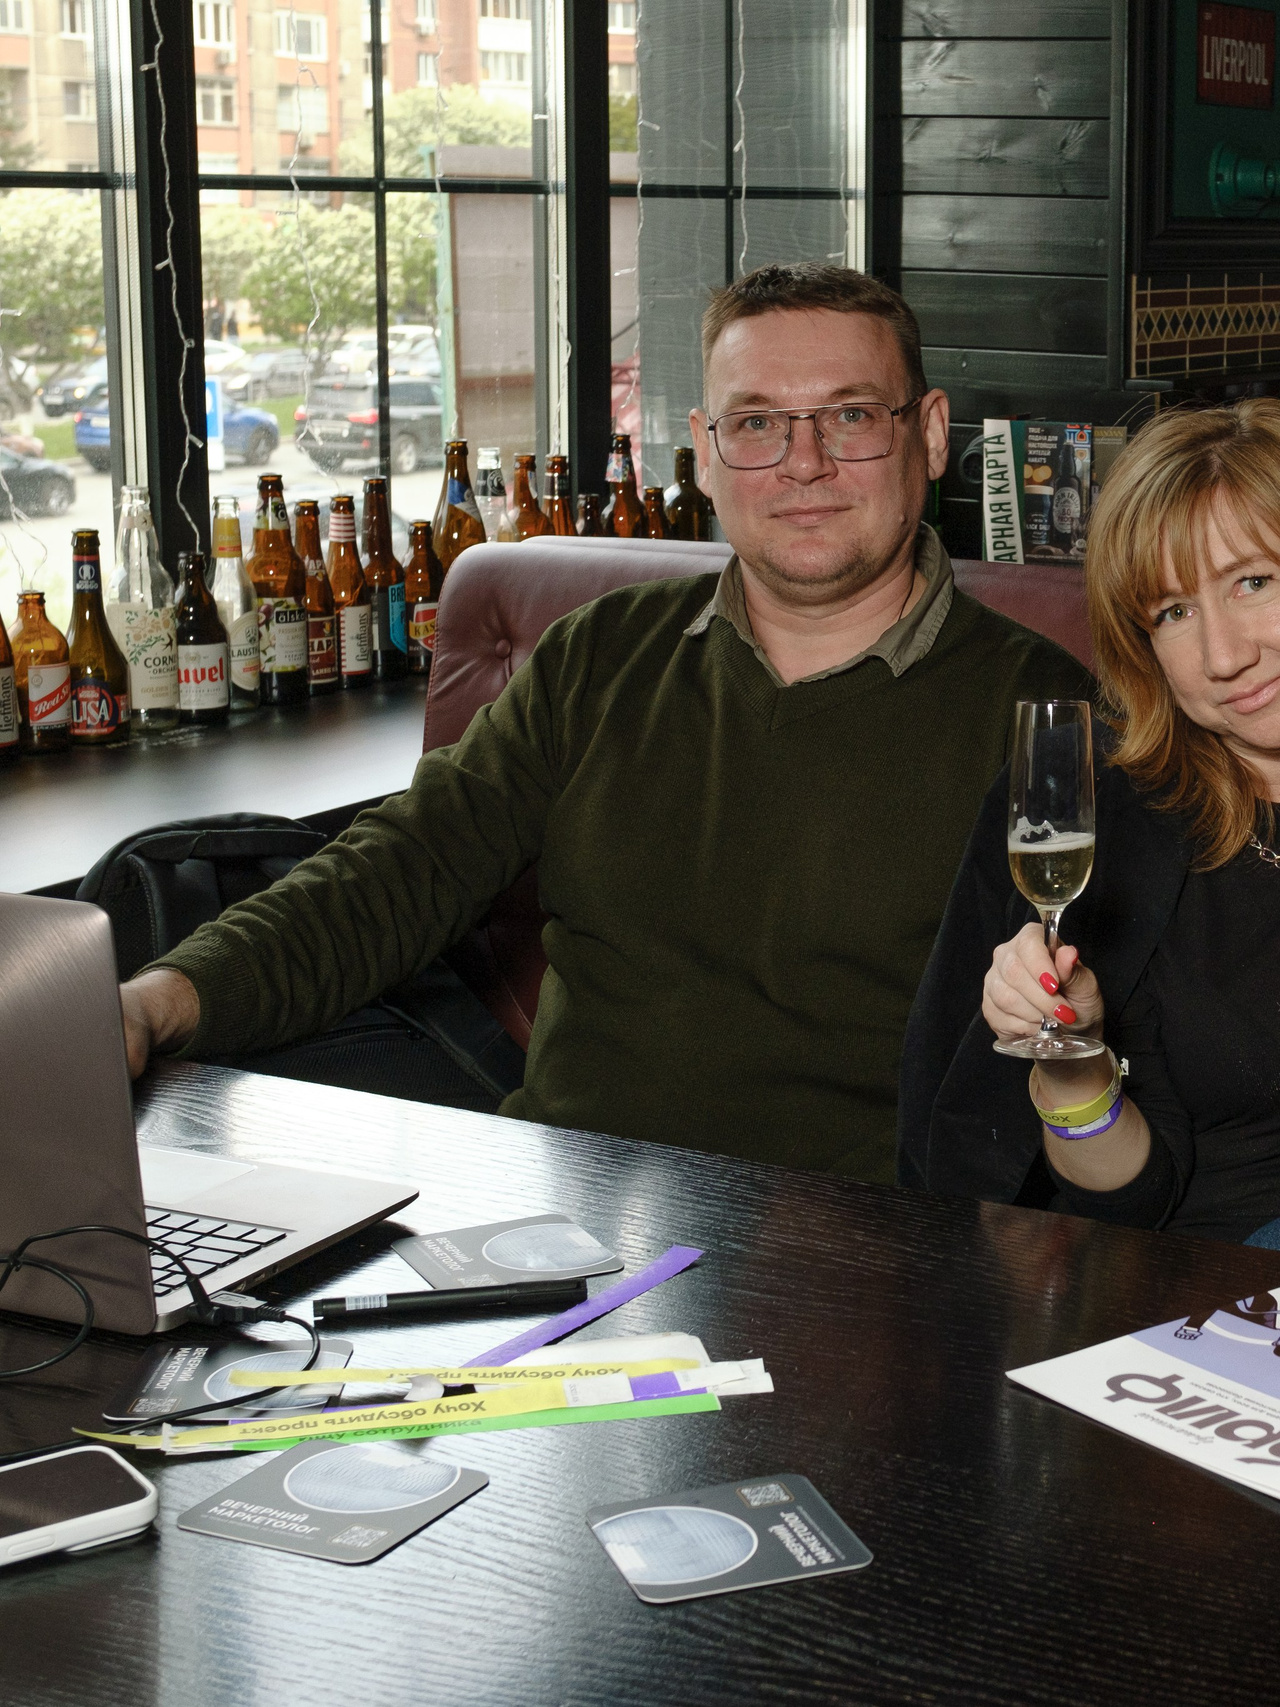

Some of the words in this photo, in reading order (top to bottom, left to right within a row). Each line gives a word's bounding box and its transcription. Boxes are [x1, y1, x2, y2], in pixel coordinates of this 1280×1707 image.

[1203, 35, 1268, 86] LIVERPOOL
[983, 433, 1011, 496] КАРТА
[355, 612, 369, 662] Liefmans
[34, 696, 60, 716] Red
[72, 698, 111, 726] LISA
[421, 1239, 464, 1272] МАРКЕТОЛОГ
[435, 1236, 474, 1264] ВЕЧЕРНИЙ
[154, 1347, 192, 1391] МАРКЕТОЛОГ
[177, 1347, 209, 1383] ВЕЧЕРНИЙ
[467, 1367, 566, 1381] обсудить
[324, 1407, 427, 1427] обсудить
[433, 1400, 487, 1415] Хочу
[239, 1420, 318, 1436] проект
[353, 1419, 482, 1438] сотрудника
[207, 1506, 321, 1535] МАРКЕТОЛОГ
[219, 1498, 310, 1523] ВЕЧЕРНИЙ
